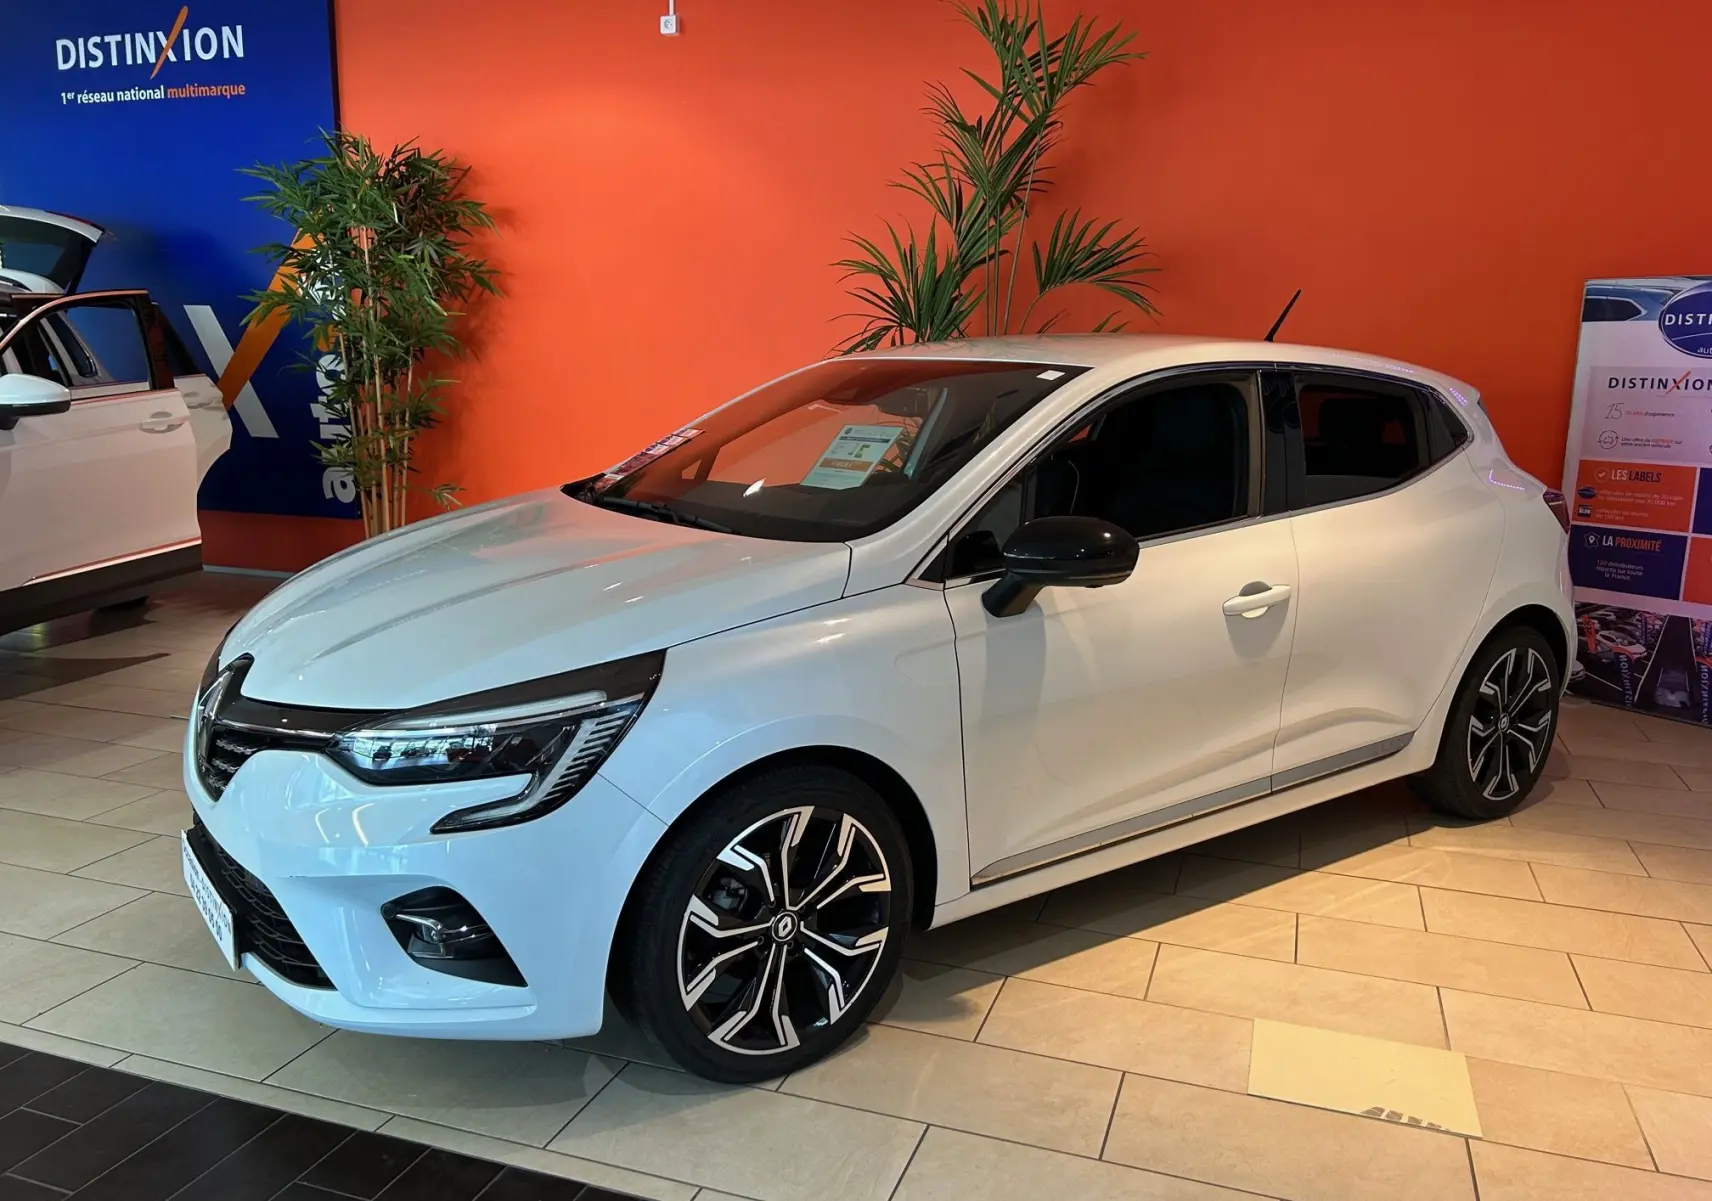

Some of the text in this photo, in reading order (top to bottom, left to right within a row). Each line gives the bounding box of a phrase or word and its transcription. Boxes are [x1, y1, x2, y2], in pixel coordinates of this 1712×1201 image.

[56, 5, 244, 79] DISTINXION
[77, 90, 114, 104] réseau
[117, 85, 165, 101] national
[167, 83, 246, 99] multimarque
[1611, 469, 1662, 482] LES LABELS
[1602, 535, 1662, 552] LA PROXIMITÉ
